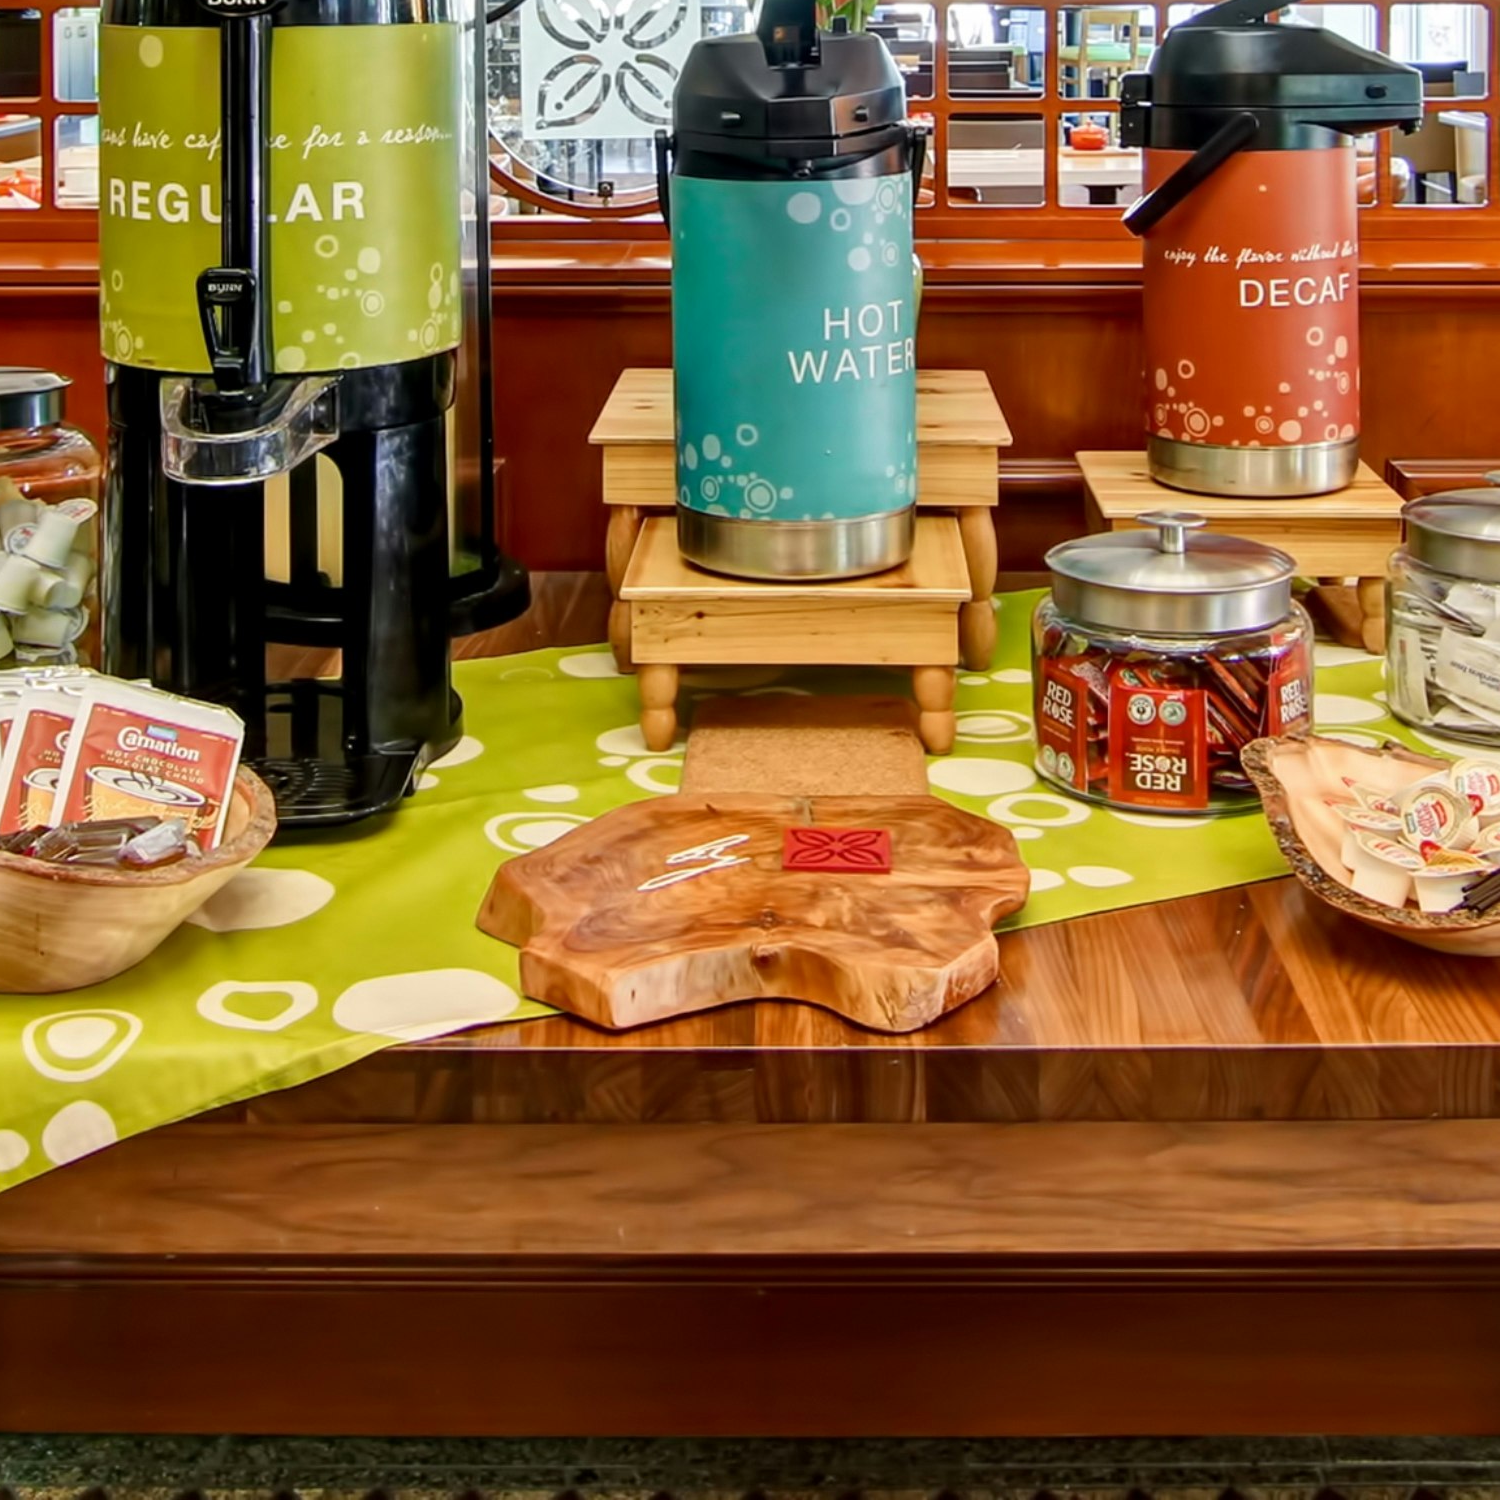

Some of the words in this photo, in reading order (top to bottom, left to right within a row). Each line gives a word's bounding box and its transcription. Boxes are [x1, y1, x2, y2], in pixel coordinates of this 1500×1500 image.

[132, 121, 174, 149] have
[184, 125, 291, 161] cafe
[302, 124, 345, 160] for
[357, 130, 371, 145] a
[109, 178, 365, 224] REGUAR
[1164, 247, 1197, 268] enjoy
[1203, 245, 1230, 263] the
[208, 283, 243, 293] BUNN
[1240, 273, 1350, 307] DECAF
[824, 299, 903, 340] HOT
[787, 337, 915, 384] WATER
[1047, 680, 1072, 707] RED
[1280, 679, 1300, 703] RED
[1042, 695, 1076, 729] ROSE
[1280, 695, 1308, 724] ROSE
[100, 753, 161, 774] CHOCOLAT
[164, 769, 205, 785] CHAUD
[106, 748, 129, 759] HOT
[134, 754, 202, 777] CHOCOLATE
[1129, 754, 1187, 775] ROSE
[1135, 773, 1181, 792] RED
